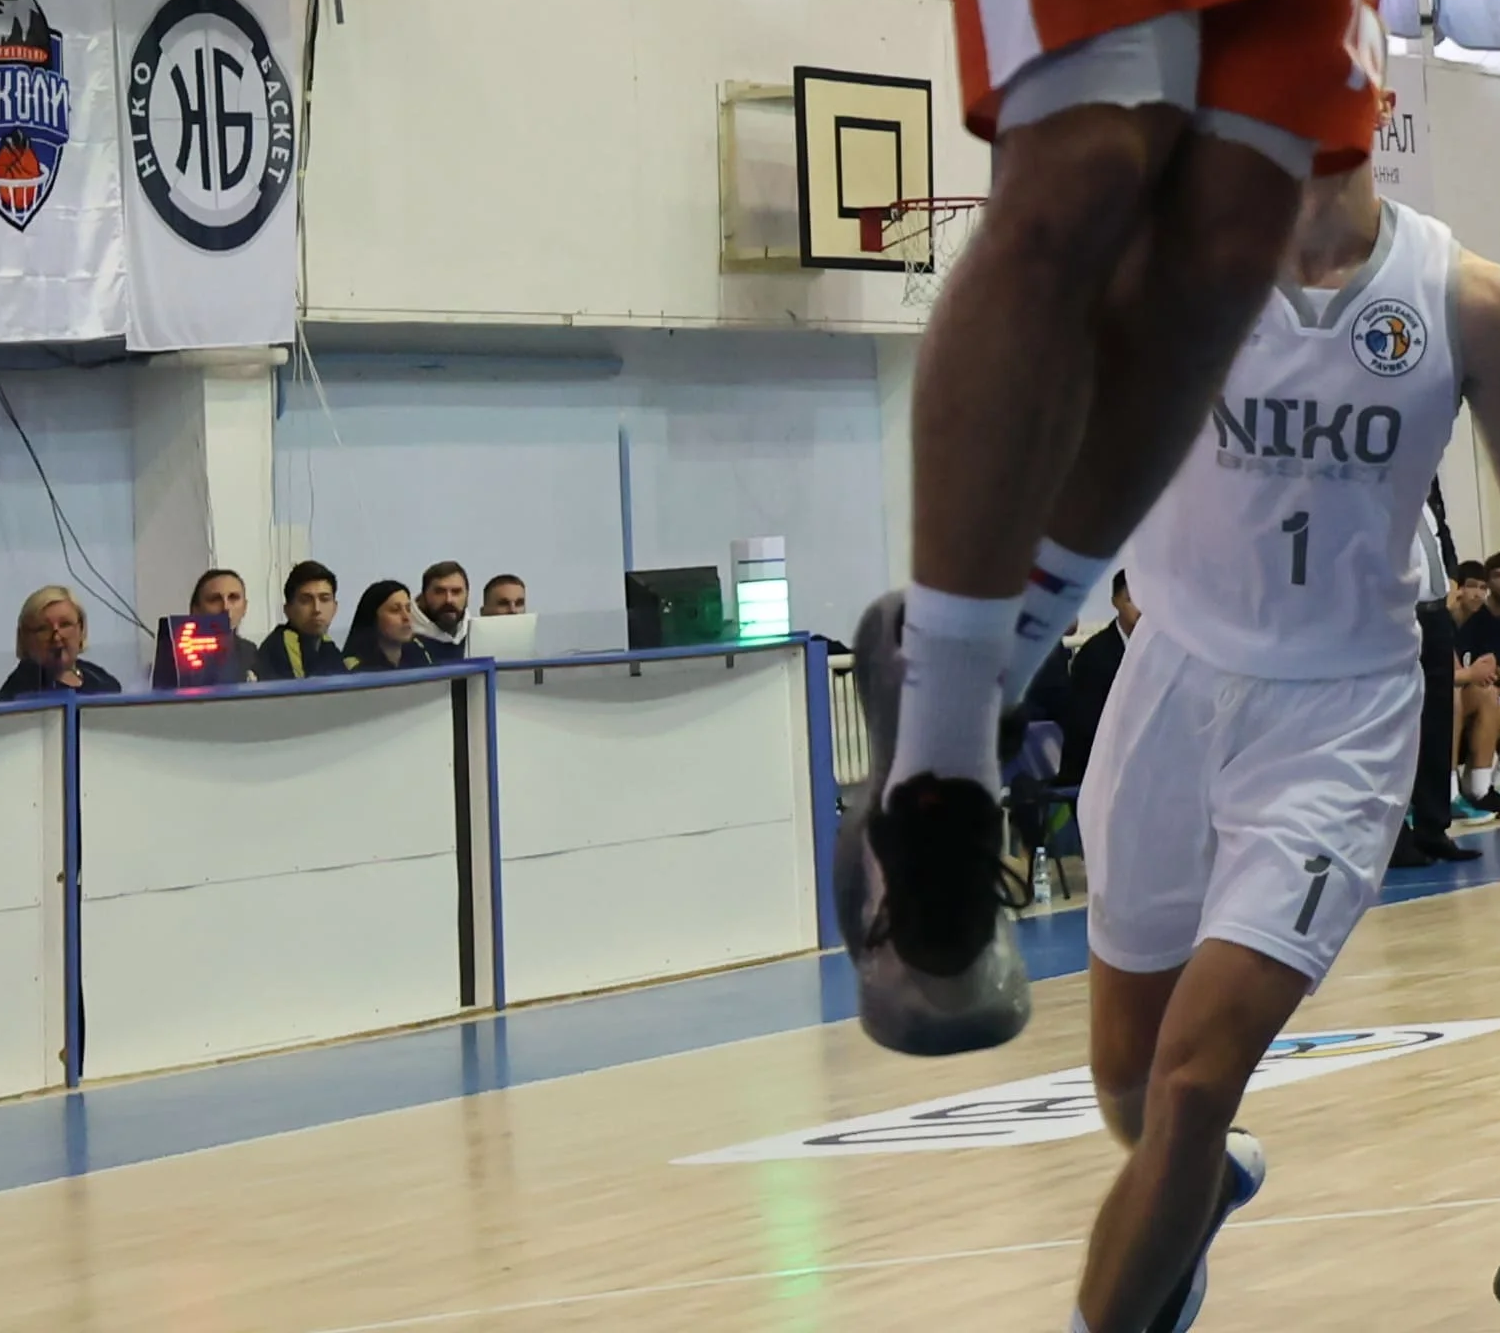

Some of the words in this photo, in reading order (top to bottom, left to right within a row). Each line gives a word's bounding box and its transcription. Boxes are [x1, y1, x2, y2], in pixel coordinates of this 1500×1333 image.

[261, 58, 295, 185] БАСКЕТ
[1212, 396, 1402, 463] NIKO
[1282, 510, 1309, 586] 1
[1295, 855, 1331, 935] 1
